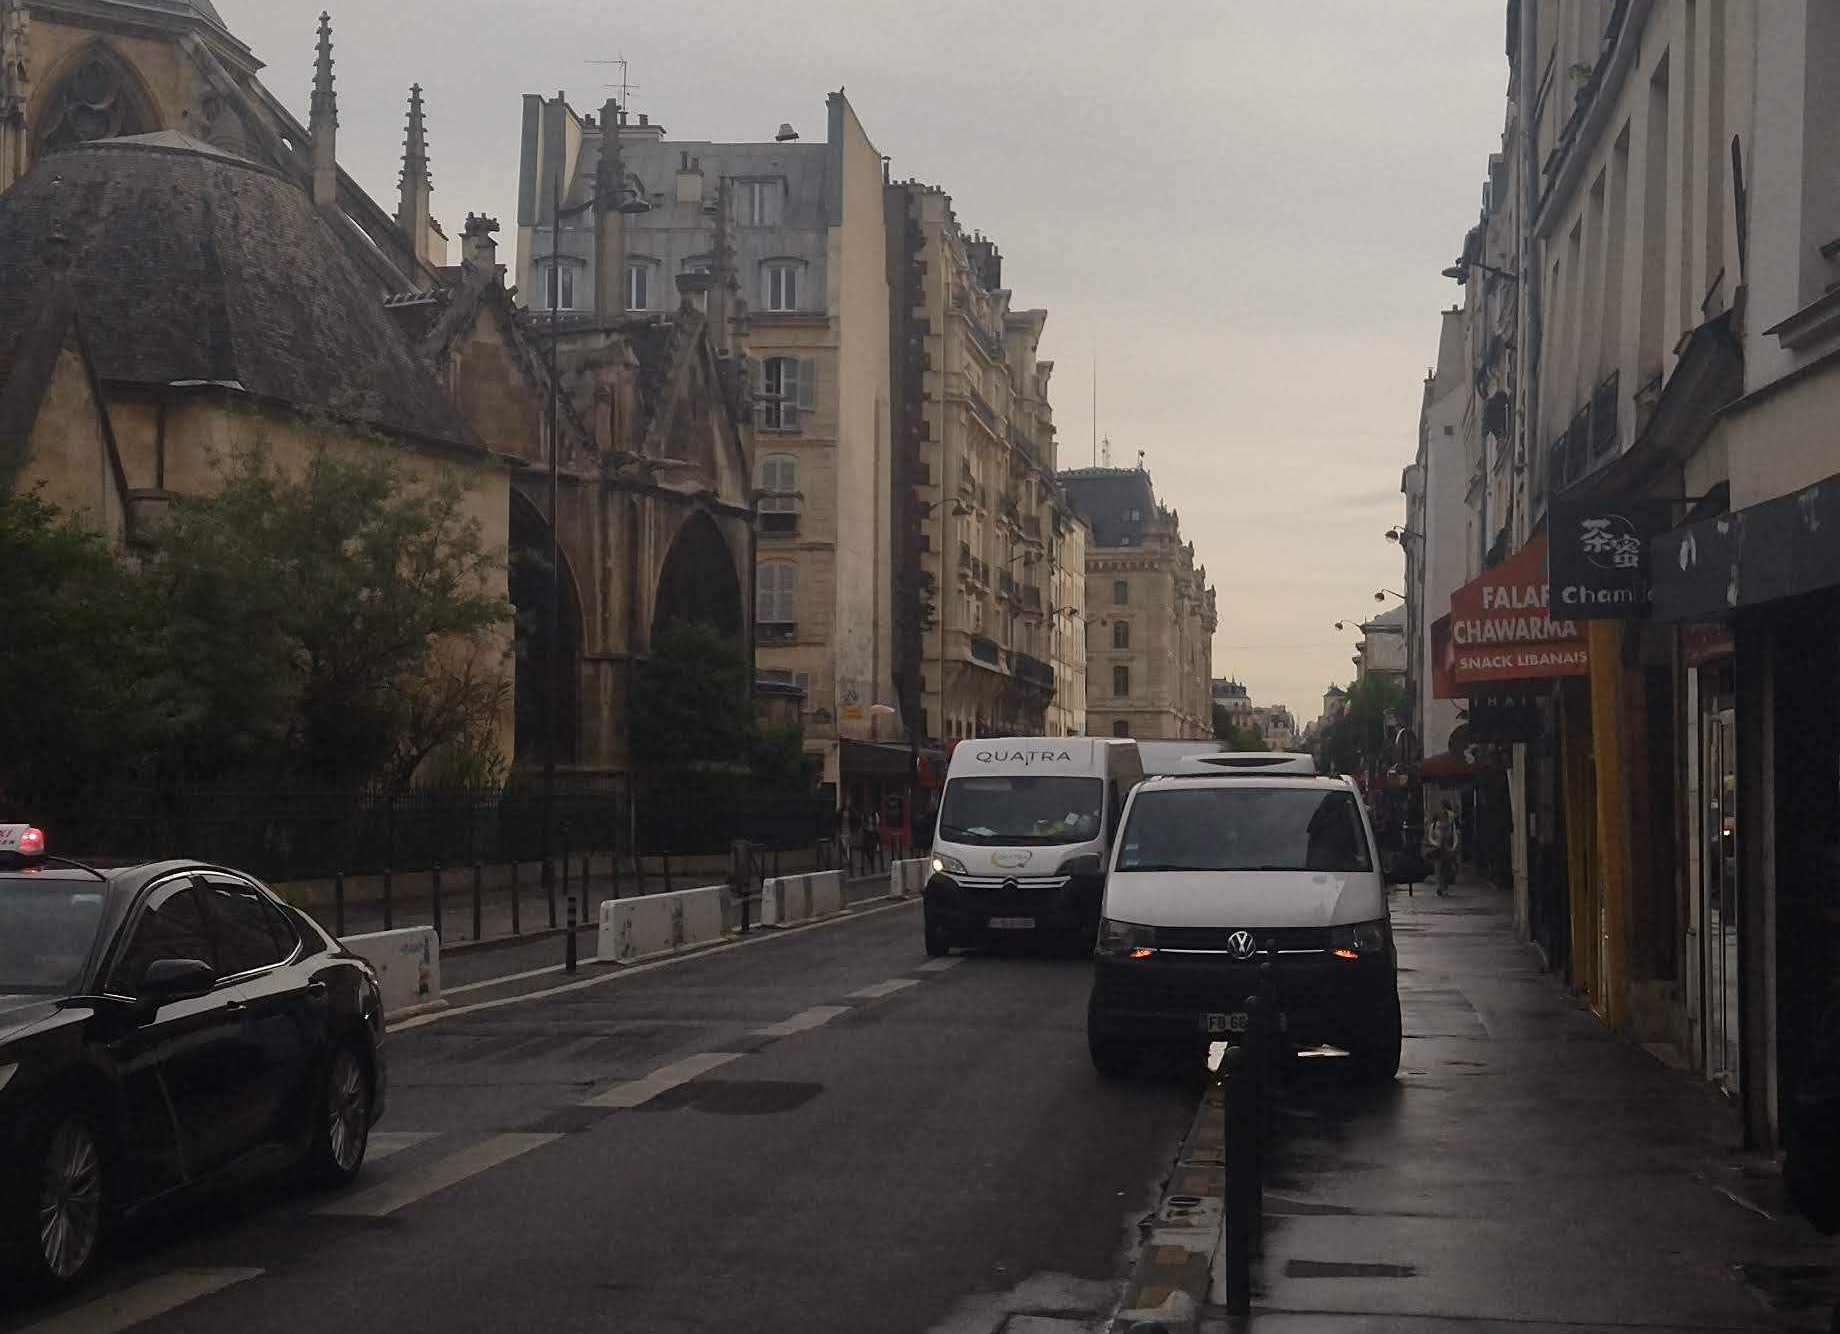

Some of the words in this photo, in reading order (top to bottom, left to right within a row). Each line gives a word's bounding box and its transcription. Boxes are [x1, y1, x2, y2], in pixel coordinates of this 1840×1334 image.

[1453, 616, 1577, 644] CHAWARMA
[1460, 655, 1513, 670] SNACK
[1517, 651, 1589, 666] LIBANAIS
[976, 751, 1071, 763] QUATRA
